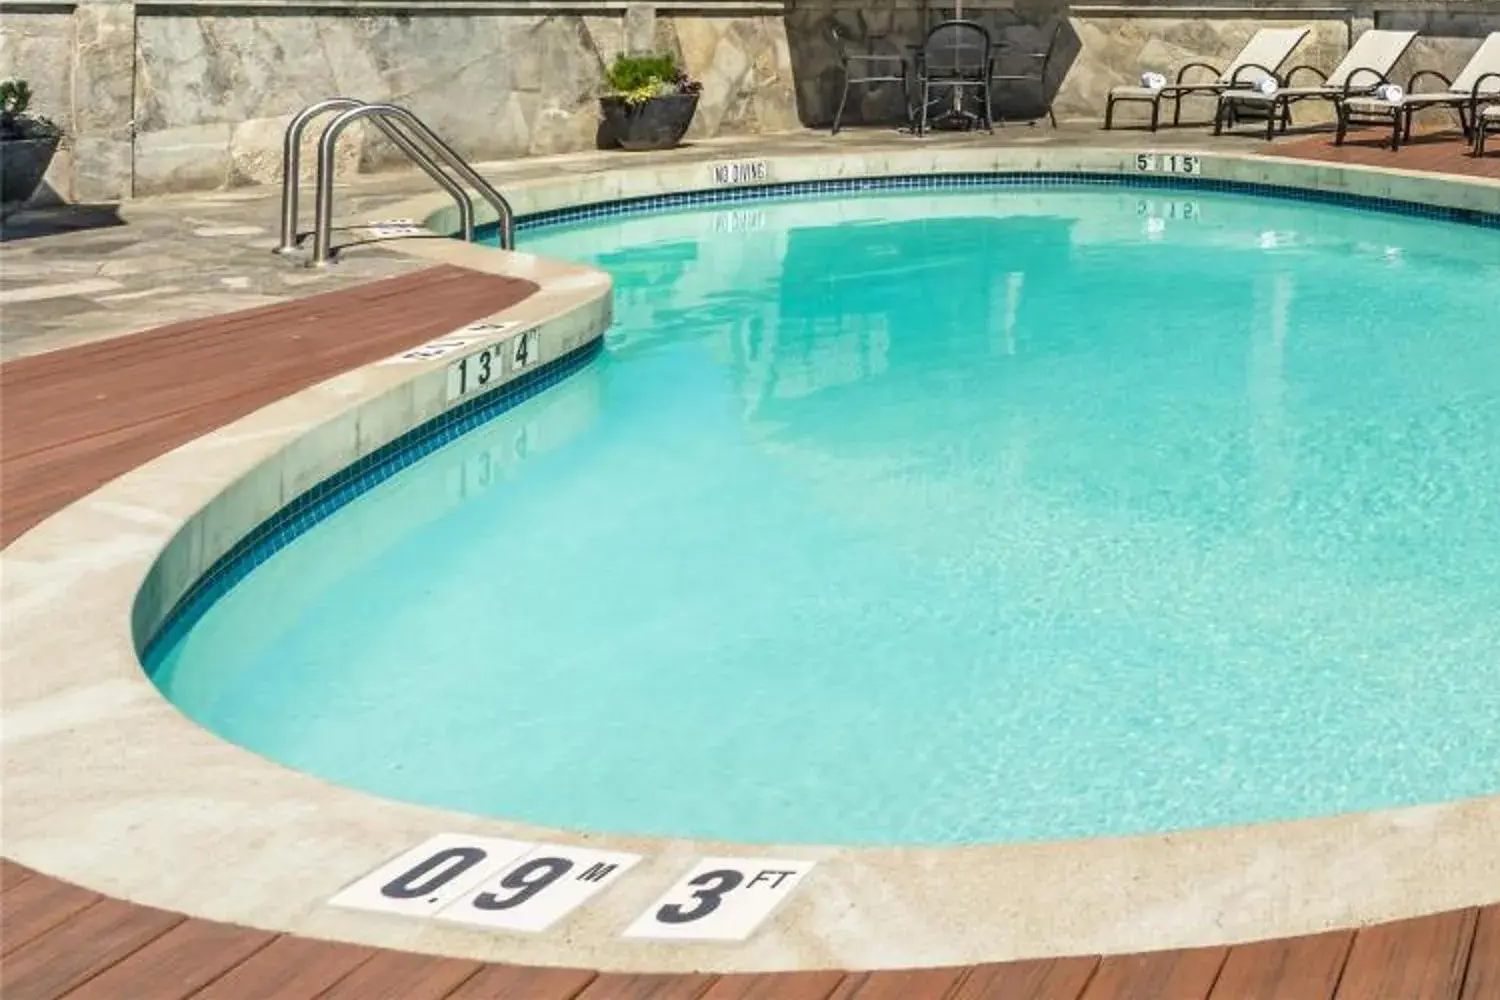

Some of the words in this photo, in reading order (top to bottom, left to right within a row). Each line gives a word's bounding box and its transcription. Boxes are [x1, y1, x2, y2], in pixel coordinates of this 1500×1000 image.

[714, 164, 729, 184] NO
[1137, 153, 1148, 171] 5
[515, 332, 529, 368] 4
[655, 868, 745, 925] 3
[745, 870, 797, 890] FT
